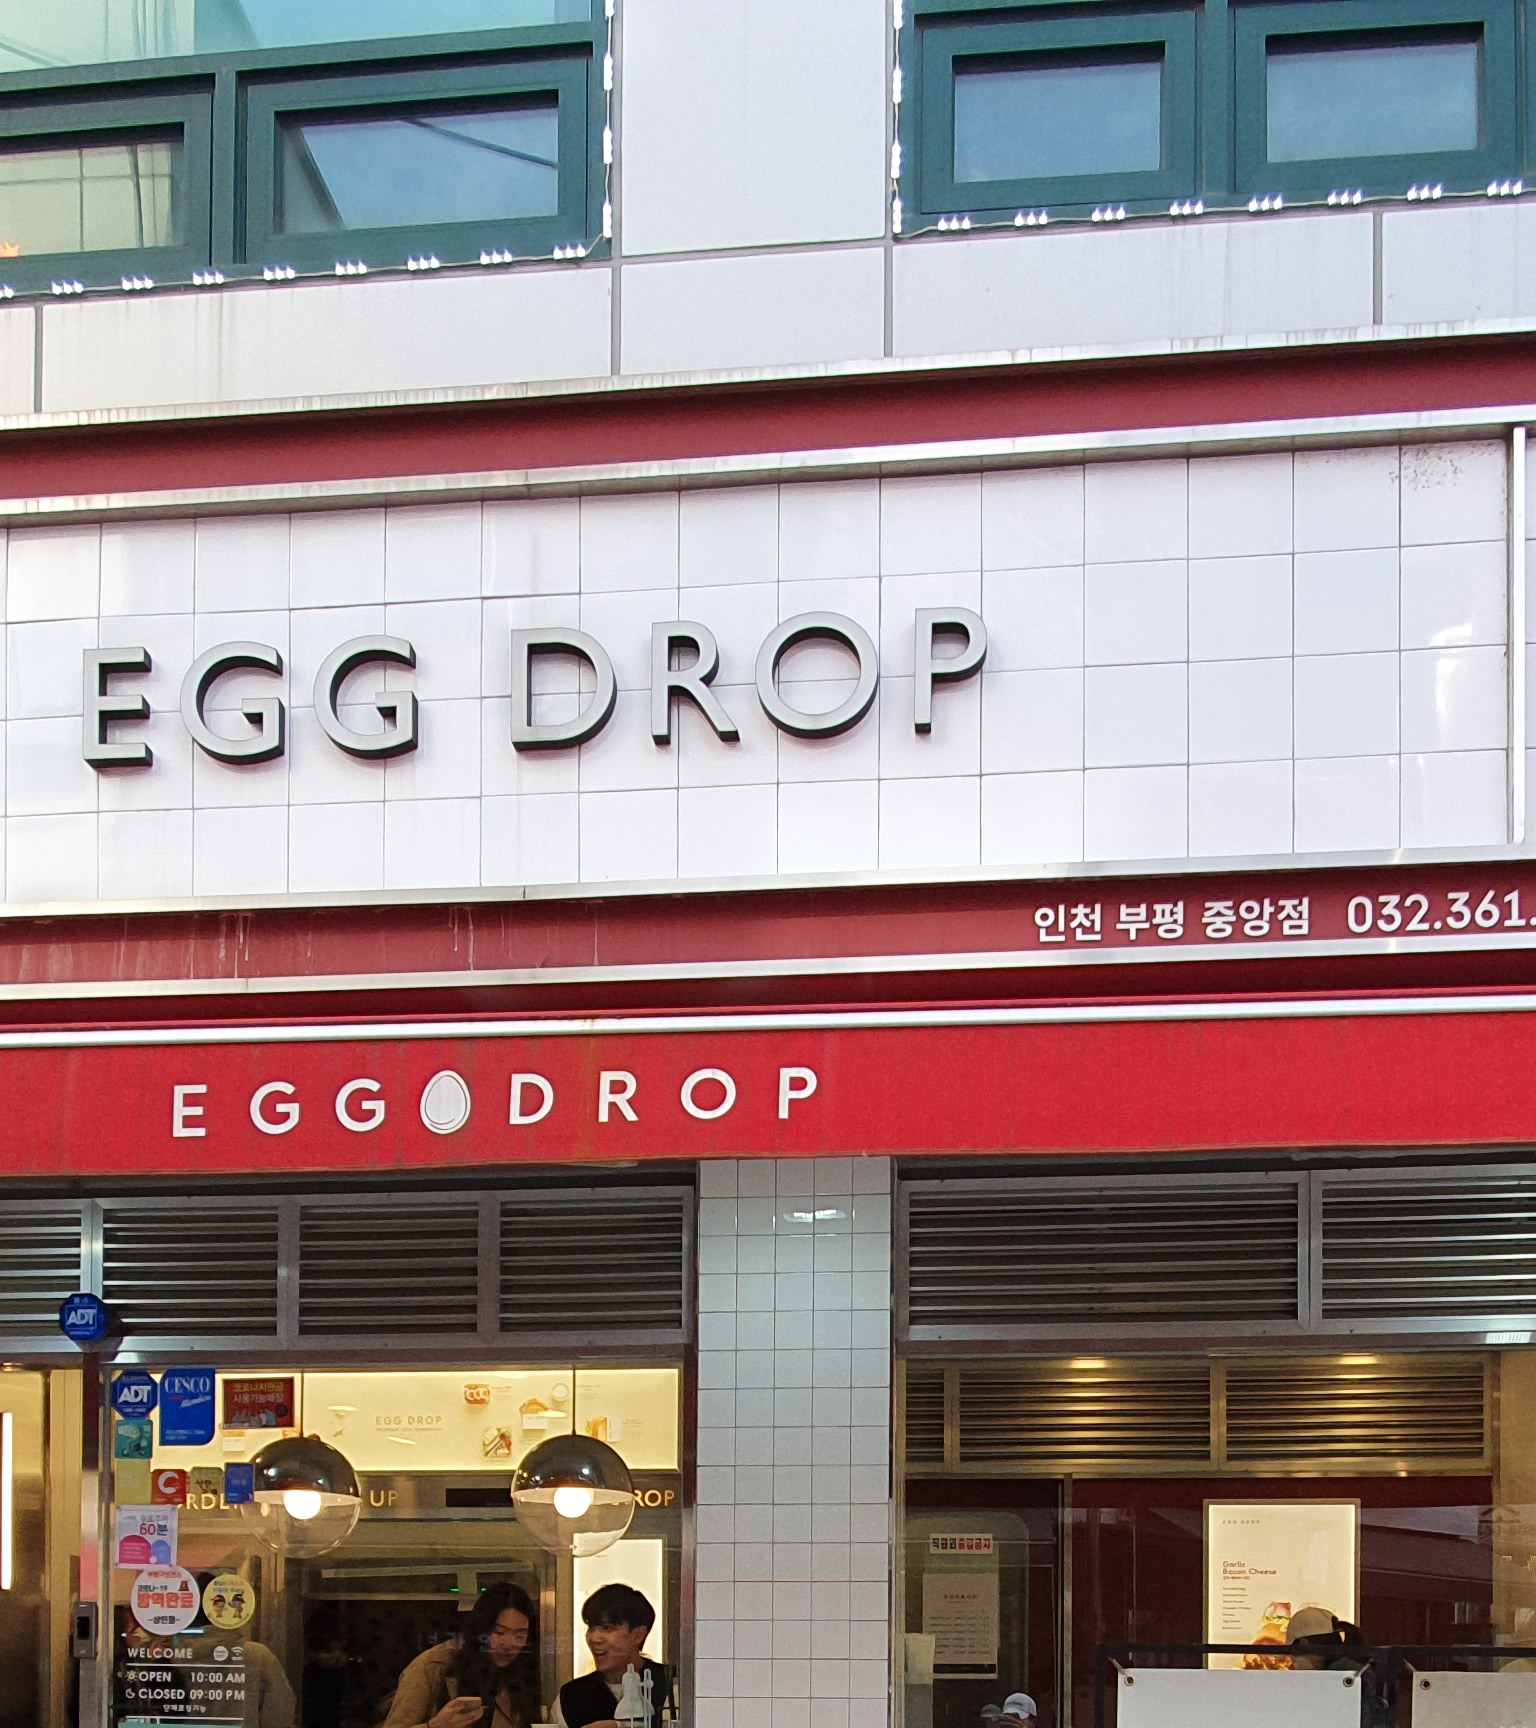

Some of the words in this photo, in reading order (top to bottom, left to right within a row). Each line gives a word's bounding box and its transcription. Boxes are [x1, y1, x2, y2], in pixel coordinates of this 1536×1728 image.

[83, 635, 418, 769] EGG
[510, 606, 988, 752] DROP
[1033, 904, 1102, 942] 인천
[1115, 902, 1185, 941] 부평
[1201, 898, 1310, 938] 중앙점
[172, 1079, 385, 1138] EGG
[509, 1067, 817, 1125] DROP
[66, 1309, 97, 1326] ADT
[165, 1376, 210, 1393] CESCO
[118, 1385, 151, 1403] ADT
[369, 1489, 399, 1508] UP
[612, 1490, 674, 1508] ROP
[127, 1647, 193, 1659] WELCOME
[138, 1670, 172, 1682] OPEN
[190, 1672, 223, 1683] 10:00
[224, 1672, 245, 1683] AM
[138, 1688, 185, 1700] CLOSED
[189, 1689, 223, 1700] 09:00
[225, 1690, 245, 1700] PM
